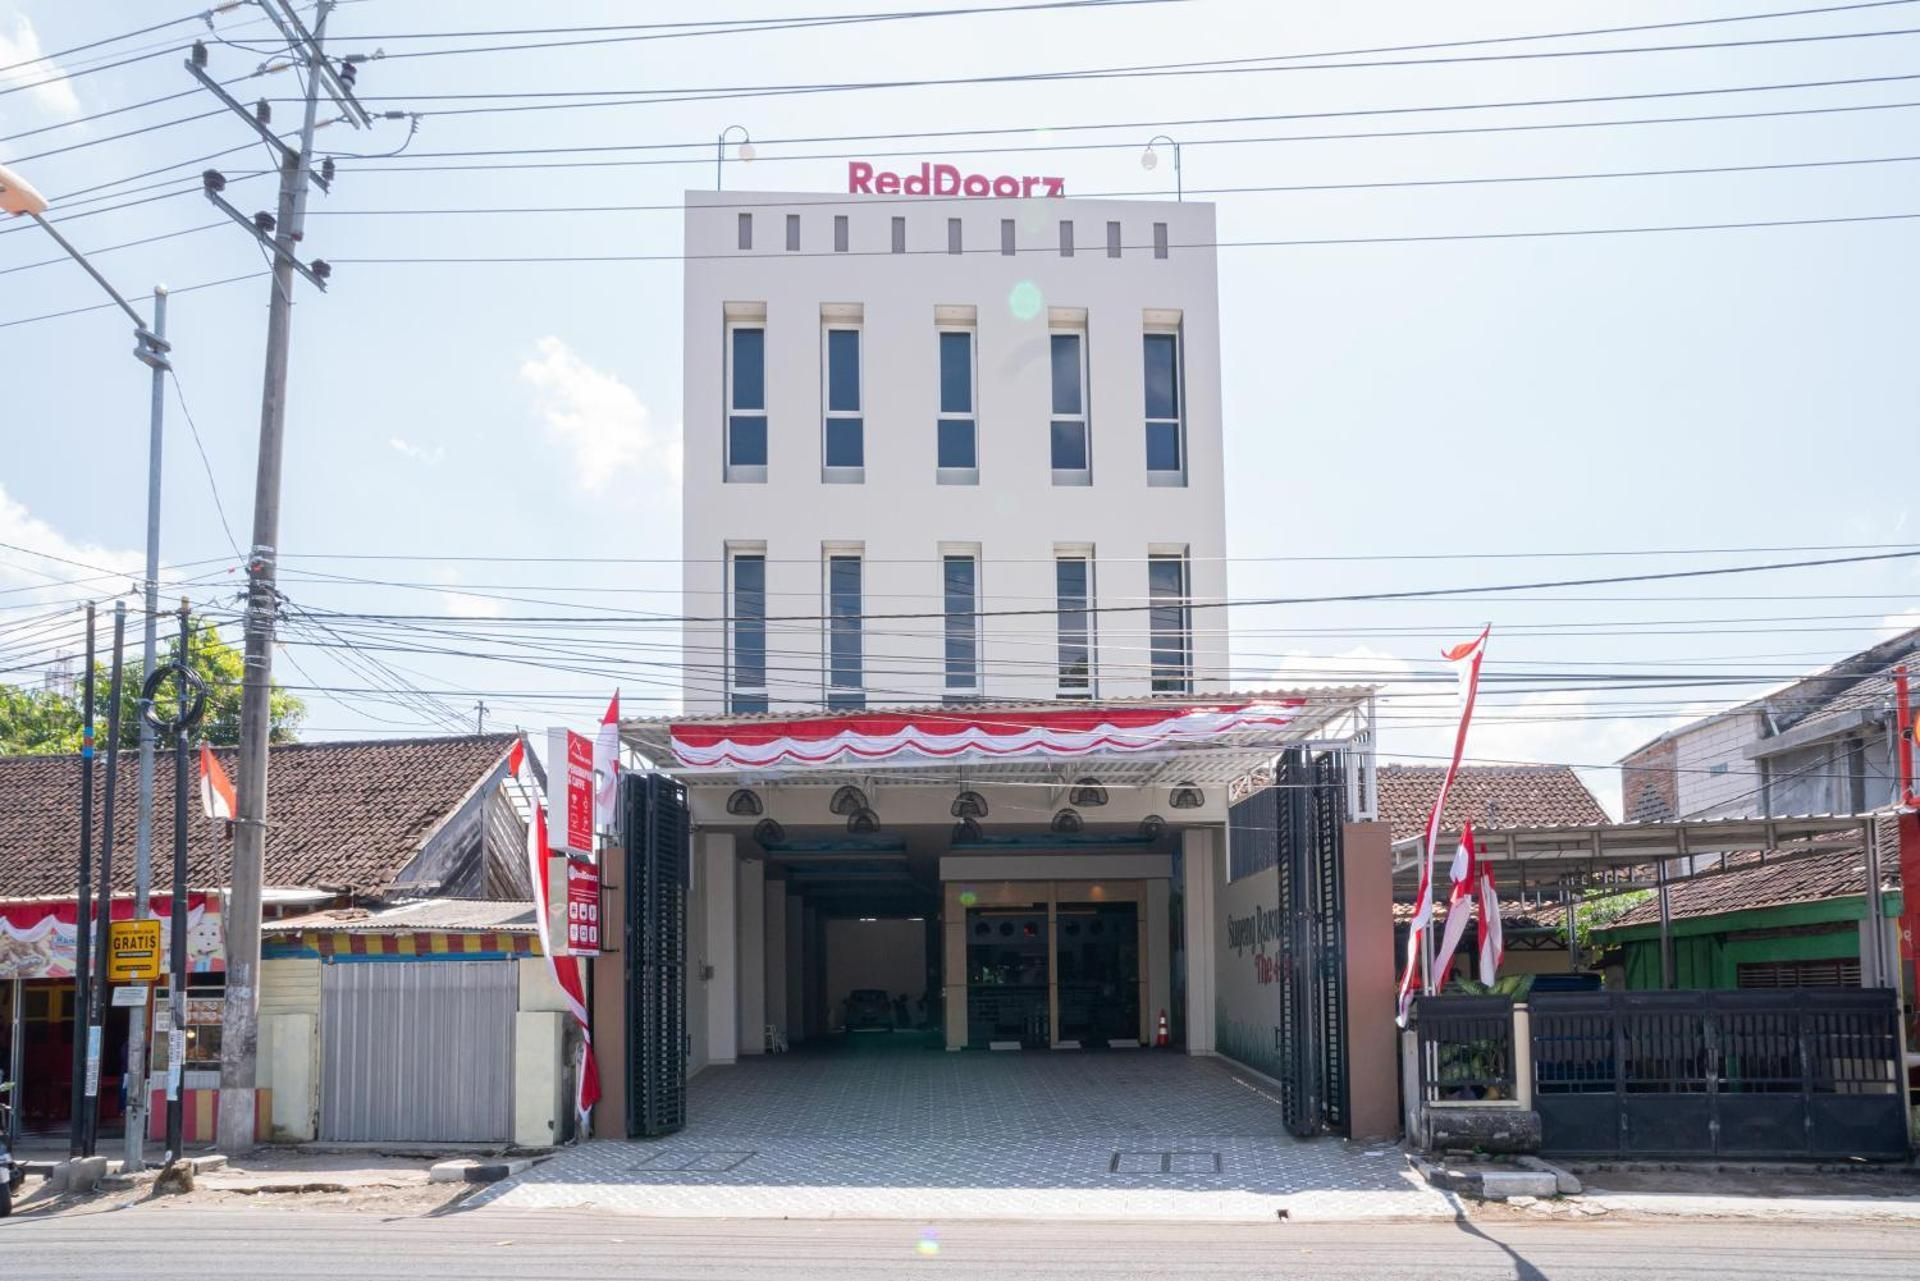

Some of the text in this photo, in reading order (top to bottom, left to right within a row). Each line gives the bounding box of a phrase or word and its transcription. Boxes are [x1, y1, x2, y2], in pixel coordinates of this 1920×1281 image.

[849, 161, 1065, 199] RedDoorz
[113, 935, 157, 950] GRATIS
[1255, 952, 1273, 984] The
